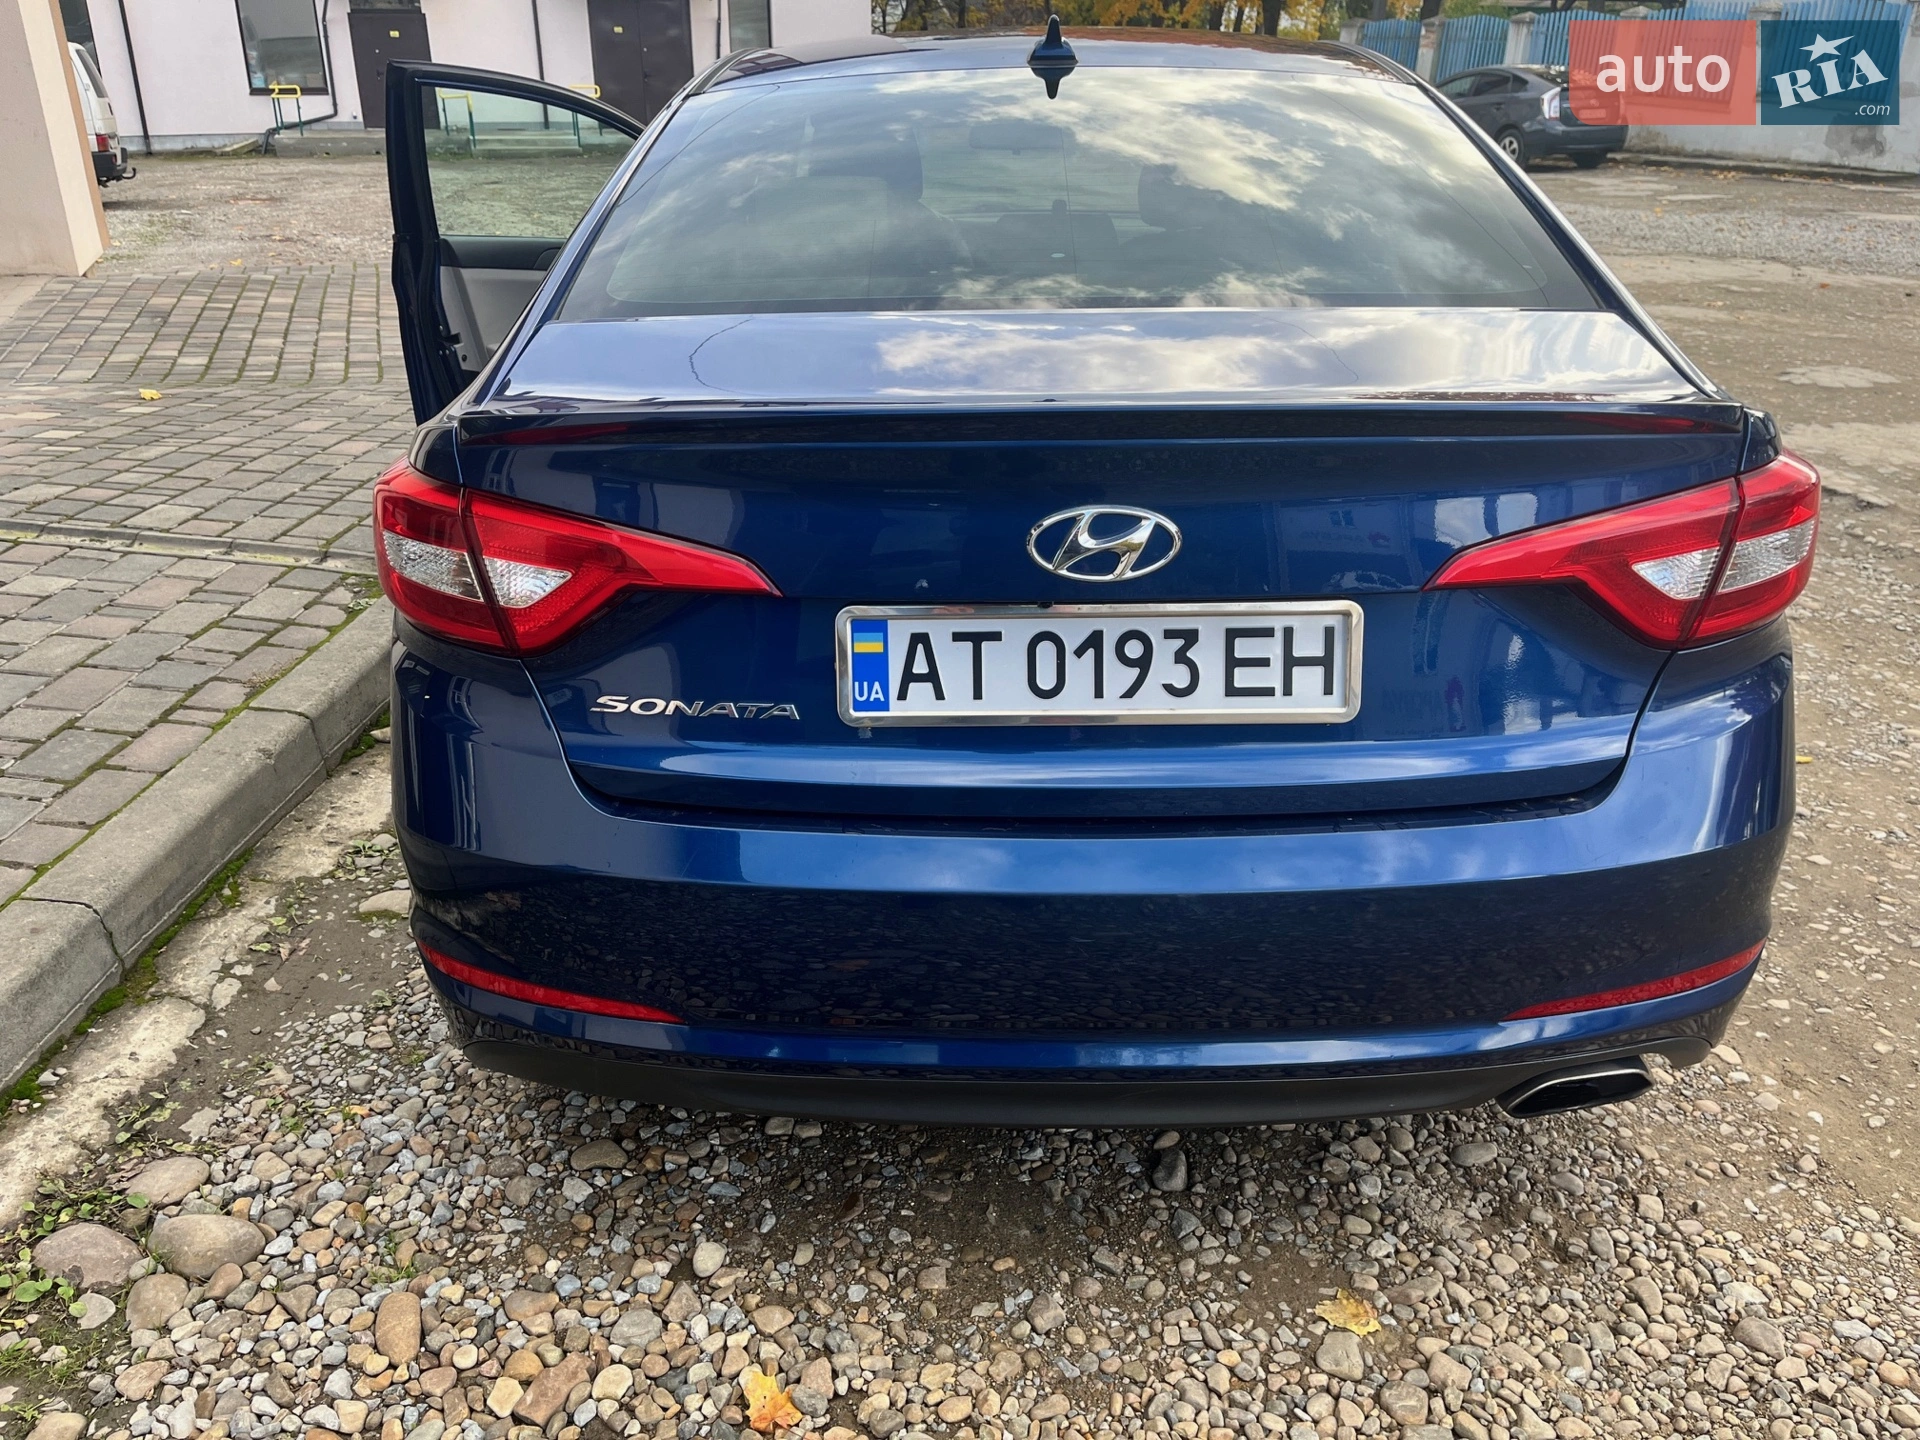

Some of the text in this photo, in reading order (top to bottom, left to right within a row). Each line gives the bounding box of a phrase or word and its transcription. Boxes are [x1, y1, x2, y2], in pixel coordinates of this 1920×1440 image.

[896, 626, 1334, 700] AT 0193 EH
[854, 681, 885, 701] UA
[589, 695, 800, 720] SONATA
